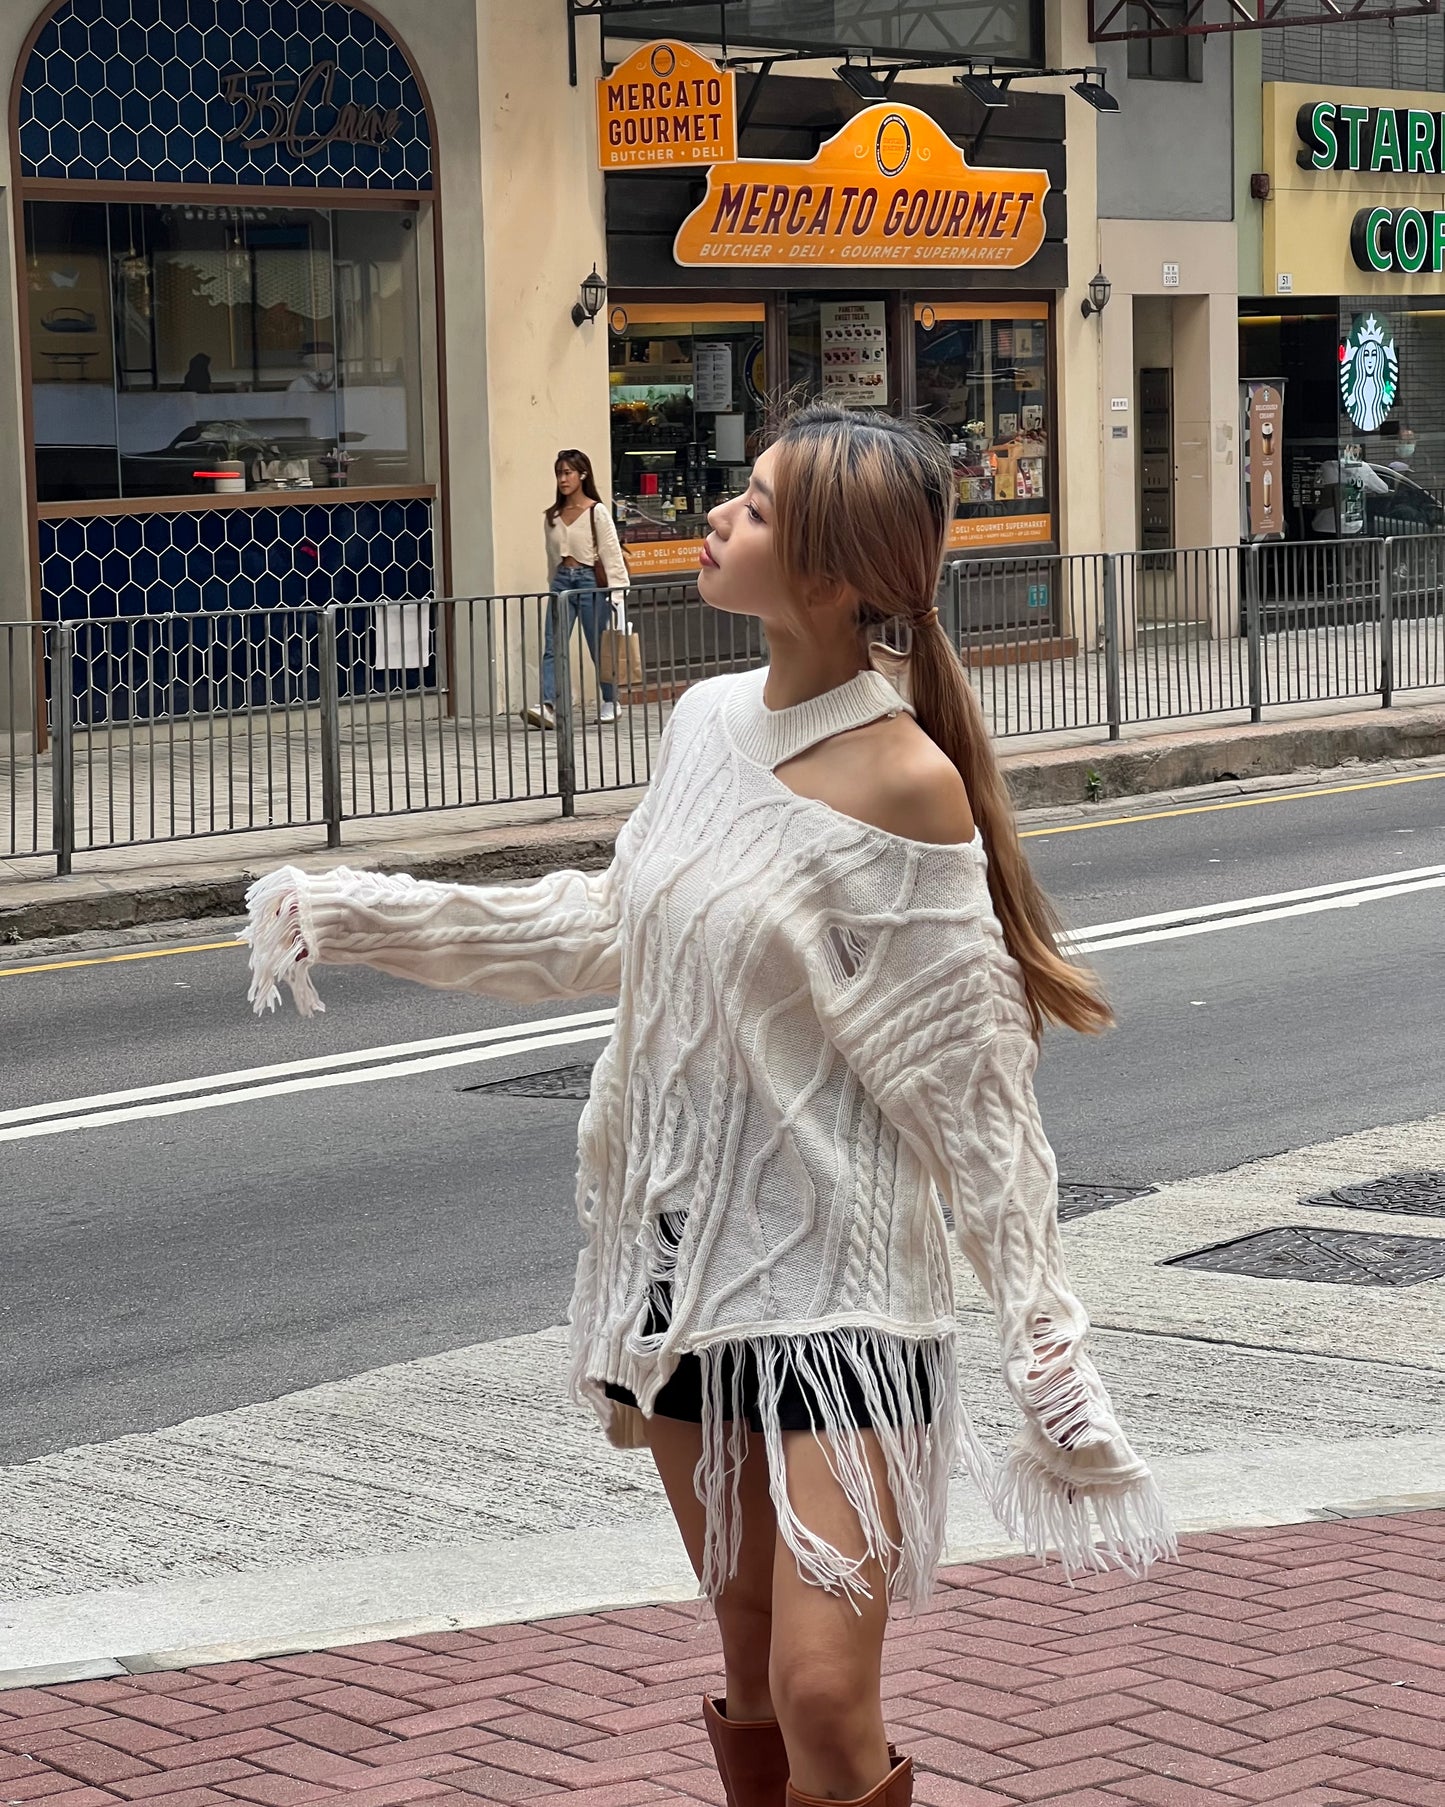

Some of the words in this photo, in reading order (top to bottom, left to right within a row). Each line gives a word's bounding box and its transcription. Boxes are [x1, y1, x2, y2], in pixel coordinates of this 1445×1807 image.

[607, 78, 721, 112] MERCATO
[221, 70, 297, 149] 55
[609, 114, 722, 146] GOURMET
[1310, 101, 1445, 173] STAR
[611, 149, 674, 162] BUTCHER
[692, 146, 724, 158] DELI
[709, 182, 878, 237] MERCATO
[883, 188, 1034, 239] GOURMET
[700, 244, 773, 257] BUTCHER
[788, 245, 825, 257] DELI
[840, 245, 911, 259] GOURMET
[913, 247, 1013, 260] SUPERMARKET
[1282, 275, 1289, 285] 51
[976, 523, 1004, 532] GOURMET
[1006, 520, 1047, 529] SUPERMARKET
[653, 548, 670, 557] DELI
